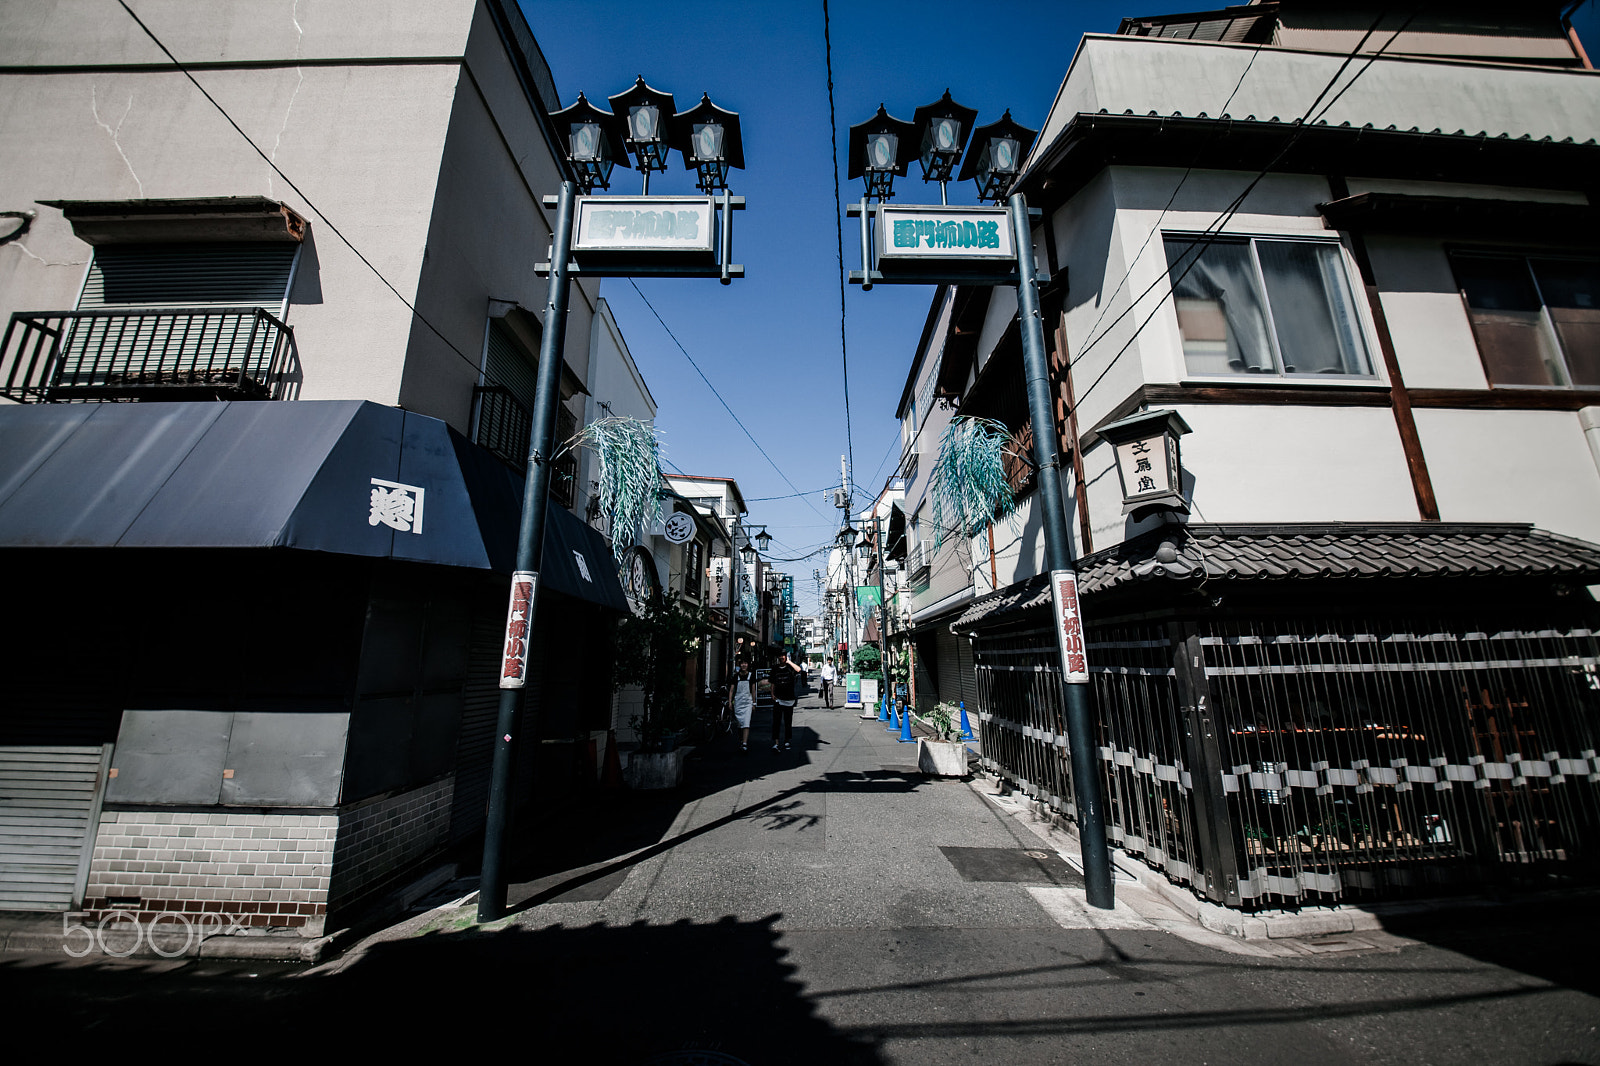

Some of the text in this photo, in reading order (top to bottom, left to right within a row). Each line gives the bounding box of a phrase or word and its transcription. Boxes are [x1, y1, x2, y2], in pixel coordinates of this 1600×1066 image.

[893, 219, 1000, 248] 雷門柳小路
[503, 581, 532, 679] 雷門柳小路
[1059, 580, 1085, 673] 雷門柳小路
